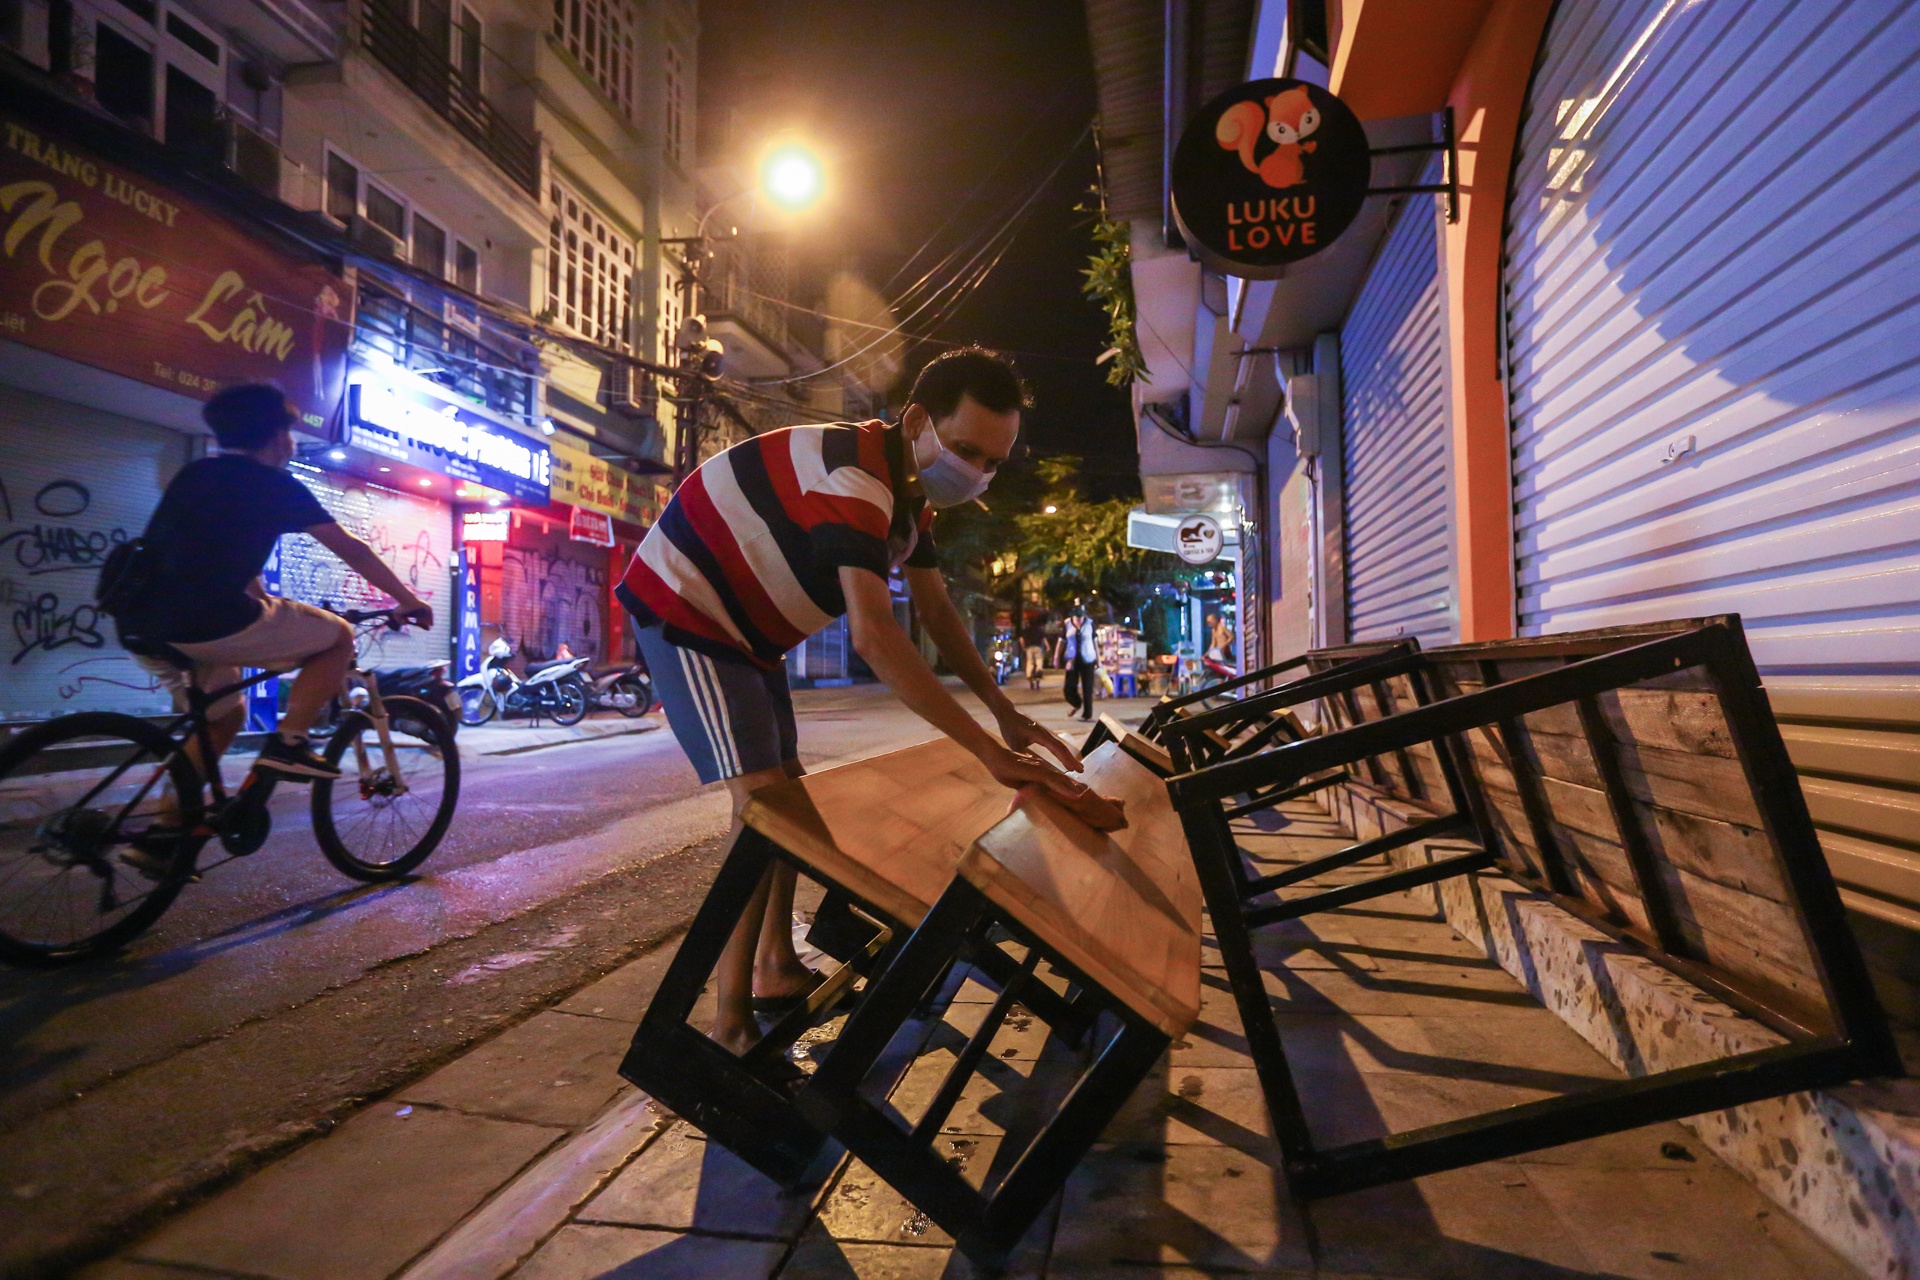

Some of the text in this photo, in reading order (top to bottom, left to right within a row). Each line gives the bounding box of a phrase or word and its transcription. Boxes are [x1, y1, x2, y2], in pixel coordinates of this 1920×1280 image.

[6, 122, 180, 227] TRANG LUCKY
[1228, 196, 1316, 225] LUKU
[1228, 222, 1317, 251] LOVE
[0, 181, 295, 361] Ngọc Lâm
